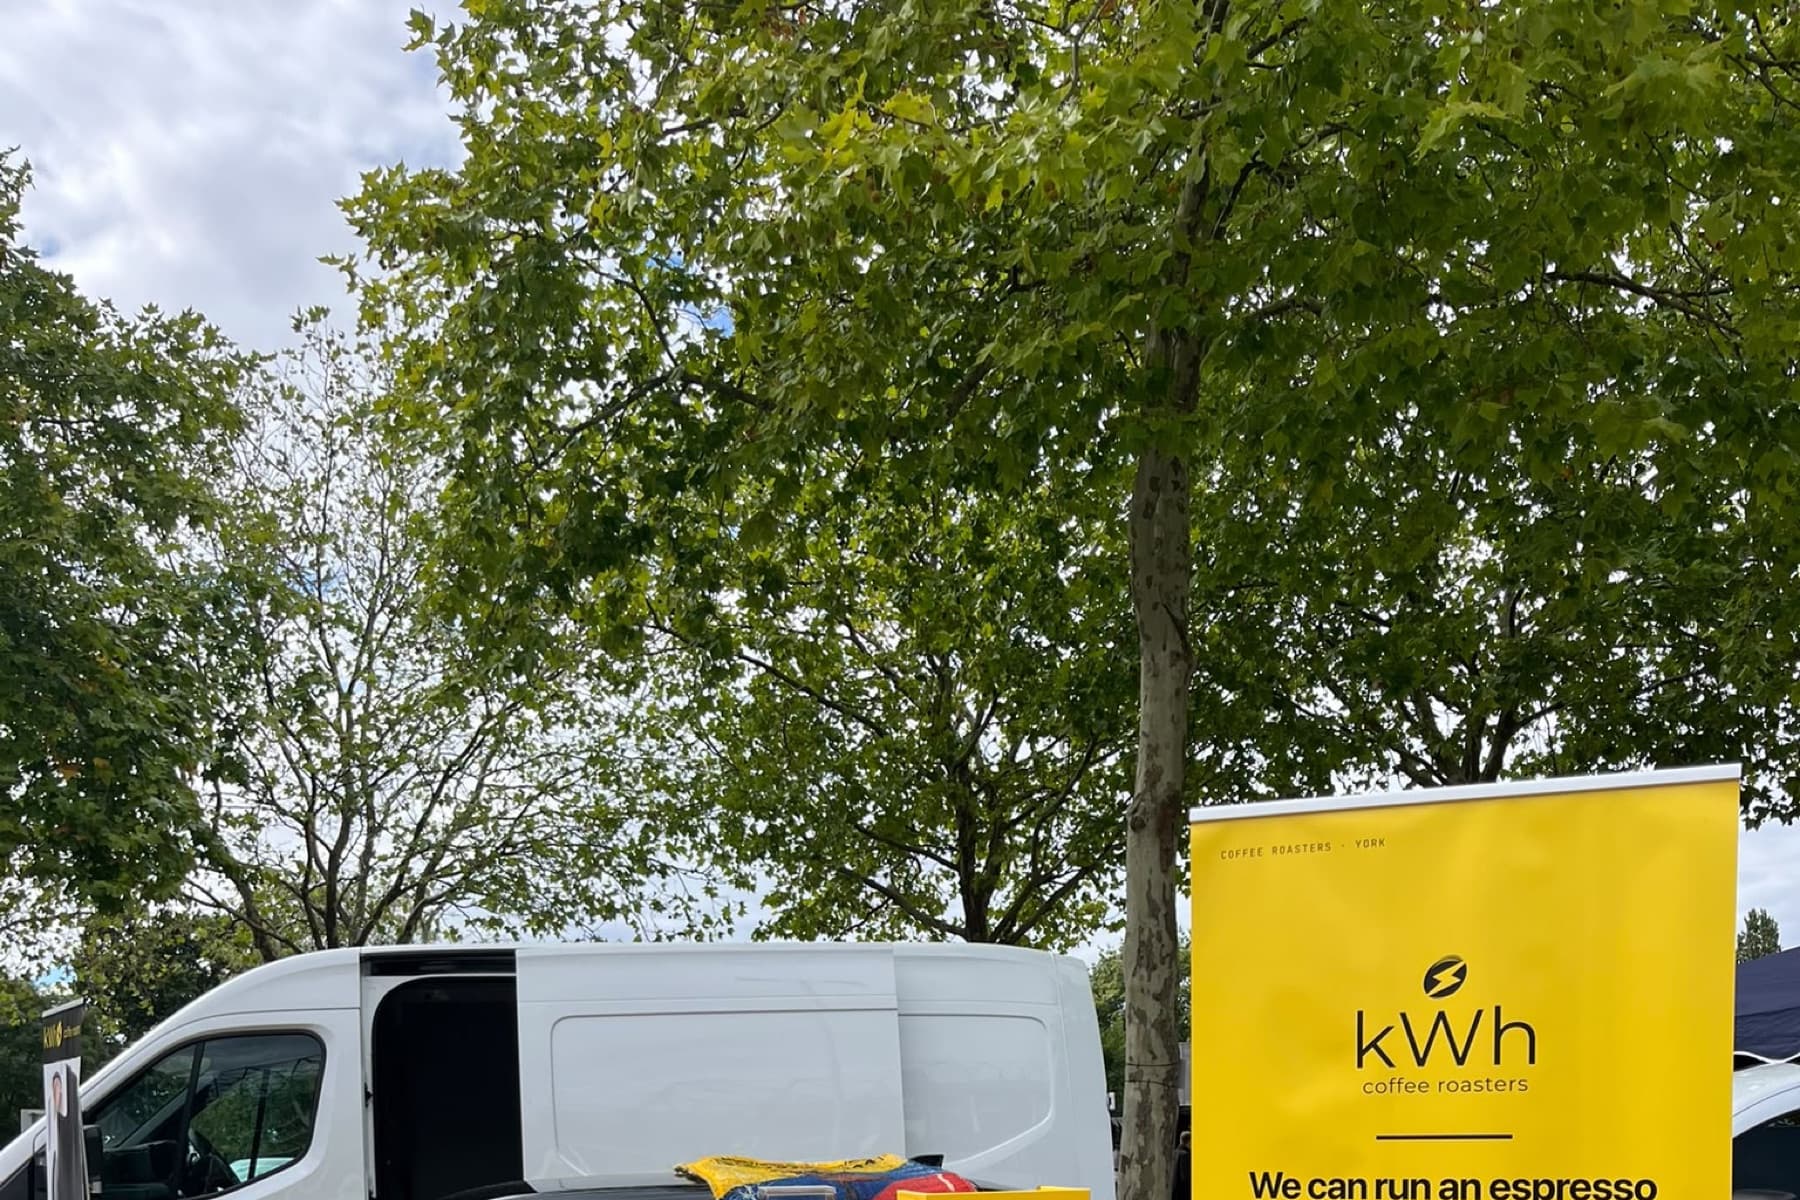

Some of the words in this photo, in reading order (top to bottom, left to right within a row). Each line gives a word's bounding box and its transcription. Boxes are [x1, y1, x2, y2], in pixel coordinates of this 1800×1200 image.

[1221, 847, 1263, 860] COFFEE
[1272, 842, 1331, 856] ROASTERS
[1355, 838, 1385, 849] YORK
[1356, 1005, 1536, 1069] kWh
[1362, 1077, 1430, 1094] coffee
[1438, 1078, 1529, 1093] roasters
[1249, 1172, 1301, 1200] We
[1307, 1177, 1367, 1200] can
[1375, 1178, 1433, 1200] run
[1439, 1179, 1481, 1200] an
